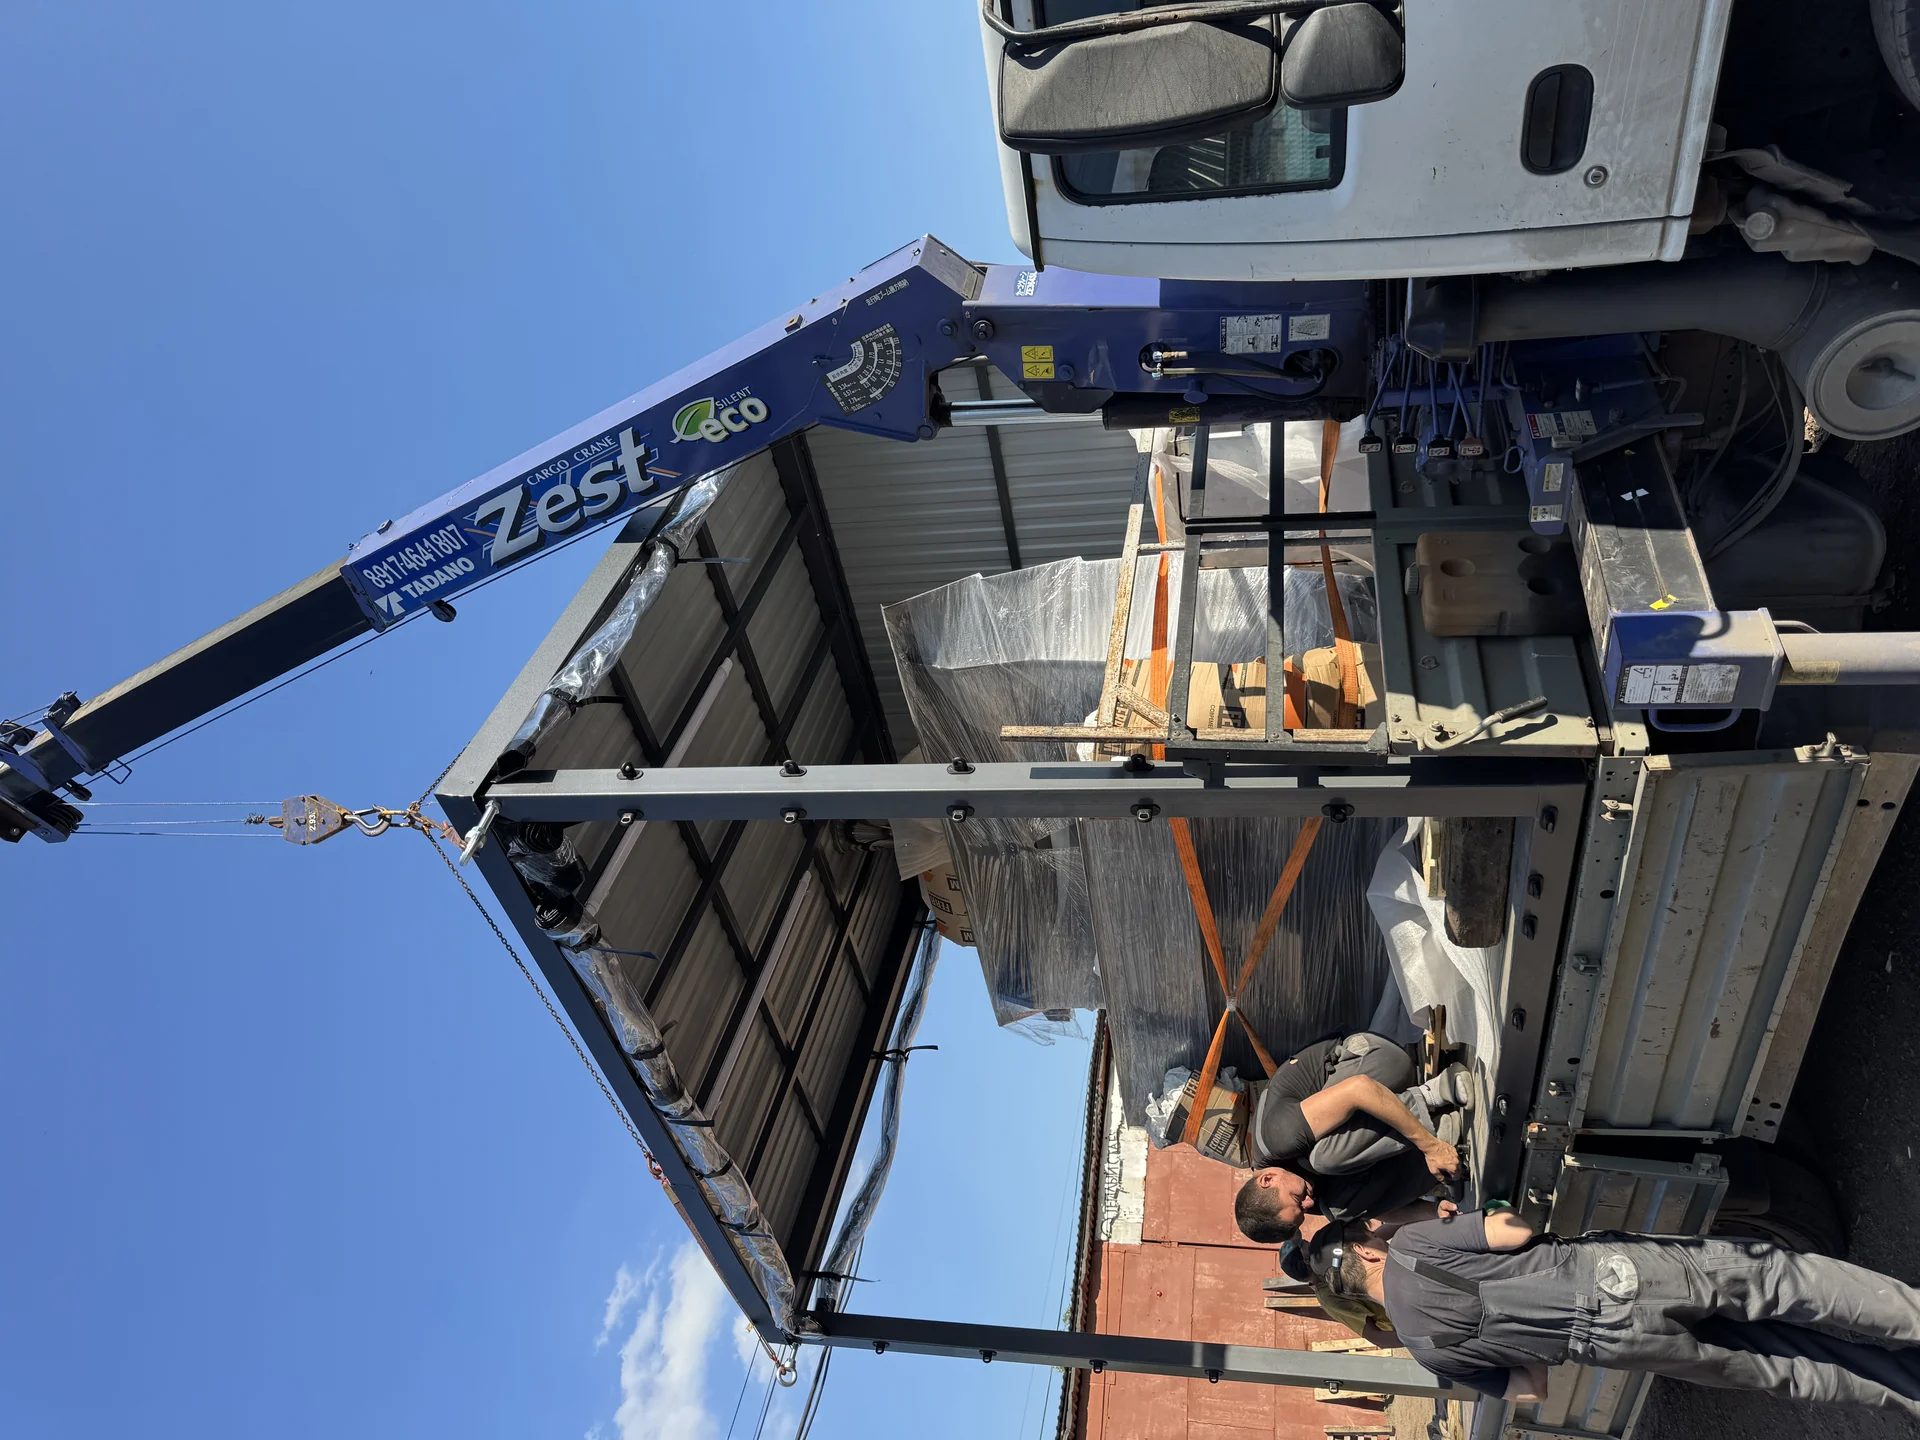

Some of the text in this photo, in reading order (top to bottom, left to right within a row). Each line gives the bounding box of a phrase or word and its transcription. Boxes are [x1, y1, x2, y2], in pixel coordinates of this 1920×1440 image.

[699, 397, 769, 443] eco
[715, 386, 751, 410] SILENT
[526, 434, 617, 487] CARGO CRANE
[474, 427, 656, 568] Zest
[401, 556, 475, 599] TADANO
[930, 896, 951, 913] FERR
